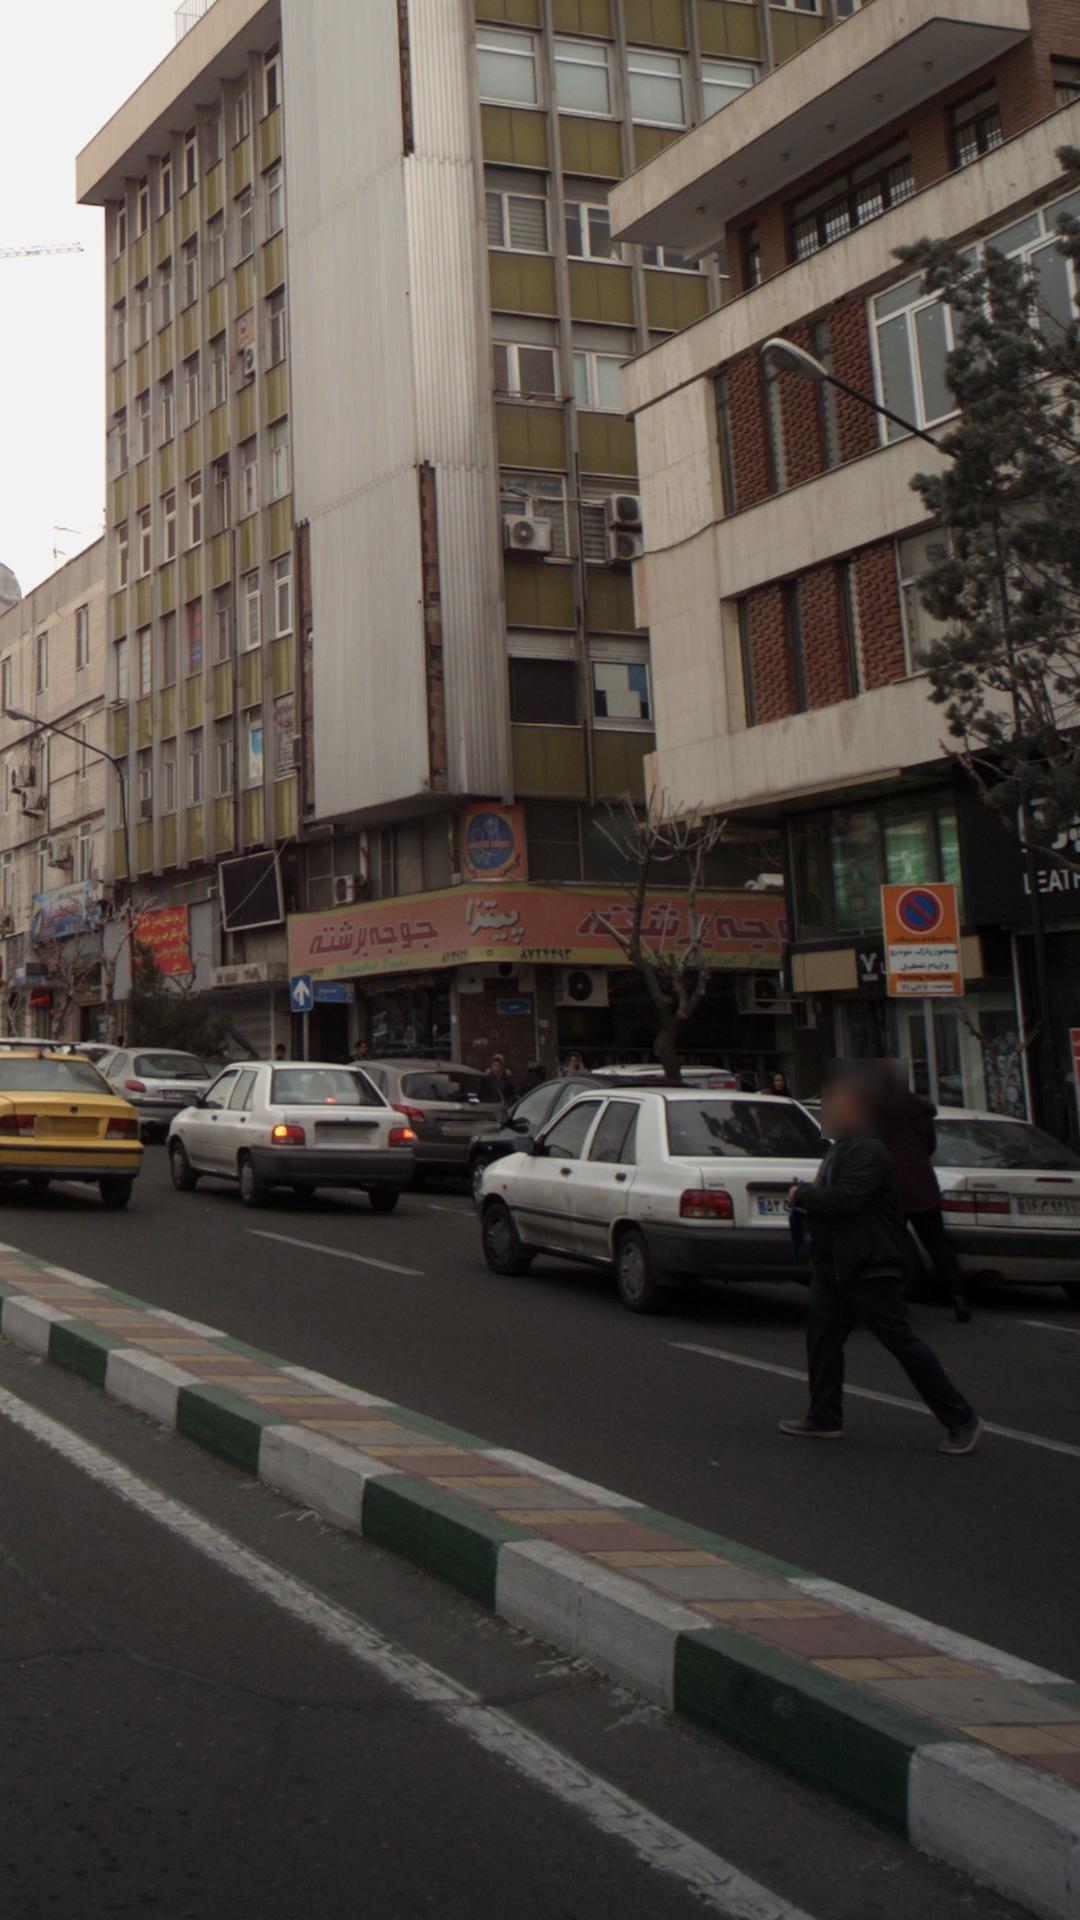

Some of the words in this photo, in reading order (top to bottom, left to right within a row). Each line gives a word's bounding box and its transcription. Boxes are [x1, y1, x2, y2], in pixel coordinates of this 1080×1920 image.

[370, 919, 438, 954] جوجه
[465, 896, 526, 944] پیتزا
[309, 921, 369, 957] برشته
